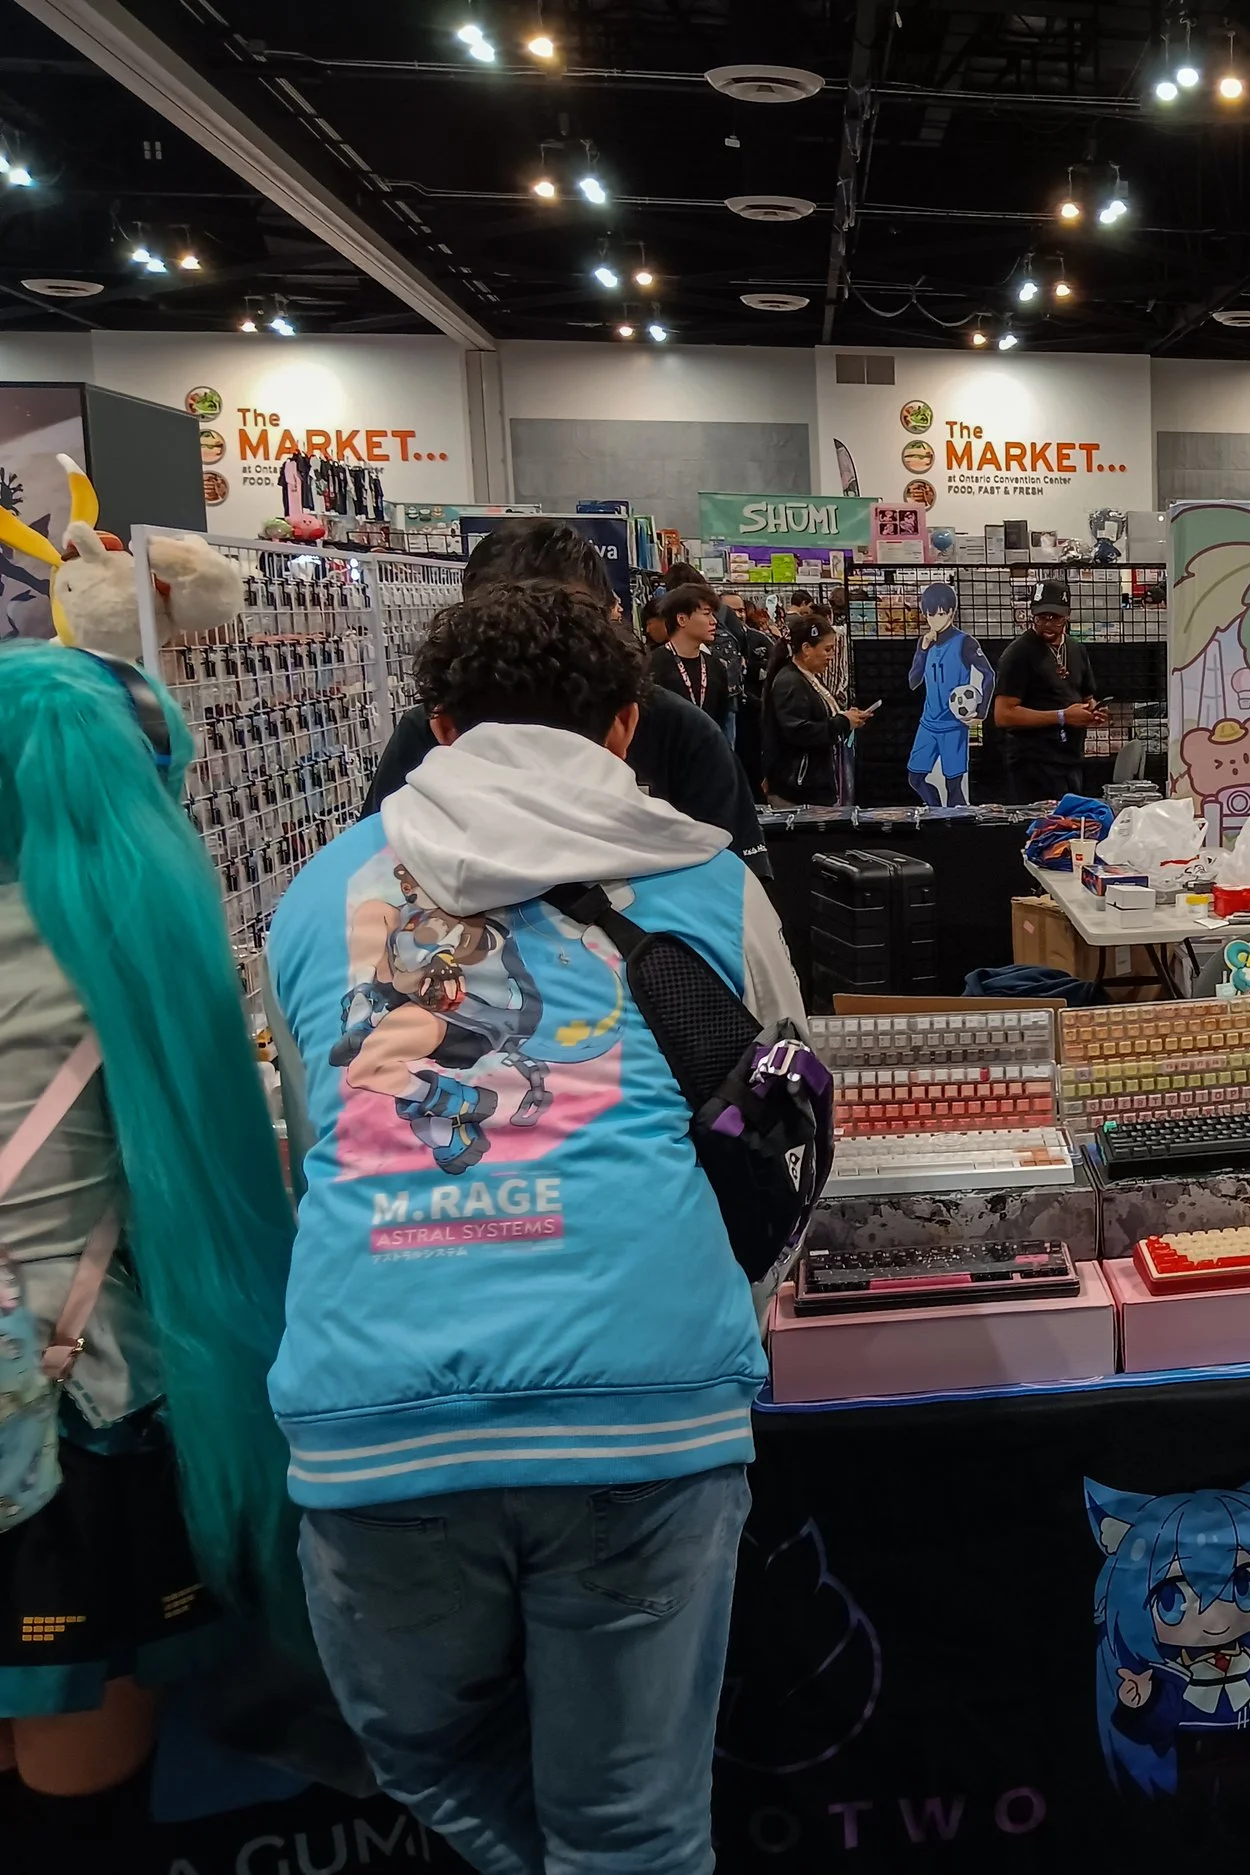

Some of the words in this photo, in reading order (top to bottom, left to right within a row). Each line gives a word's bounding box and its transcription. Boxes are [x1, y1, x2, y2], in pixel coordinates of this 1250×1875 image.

[237, 408, 281, 427] The
[945, 421, 983, 439] The
[946, 441, 1128, 472] MARKET...
[947, 475, 957, 483] at
[959, 474, 991, 484] Ontario
[994, 474, 1041, 485] Convention
[1043, 475, 1072, 485] Center
[947, 485, 975, 495] FOOD,
[978, 485, 1001, 495] FAST
[1003, 486, 1010, 495] &
[1013, 486, 1044, 496] FRESH
[931, 662, 945, 684] 11
[371, 1177, 563, 1226] M.RAGE
[376, 1226, 456, 1248] ASTRAL
[462, 1218, 556, 1240] SYSTEMS
